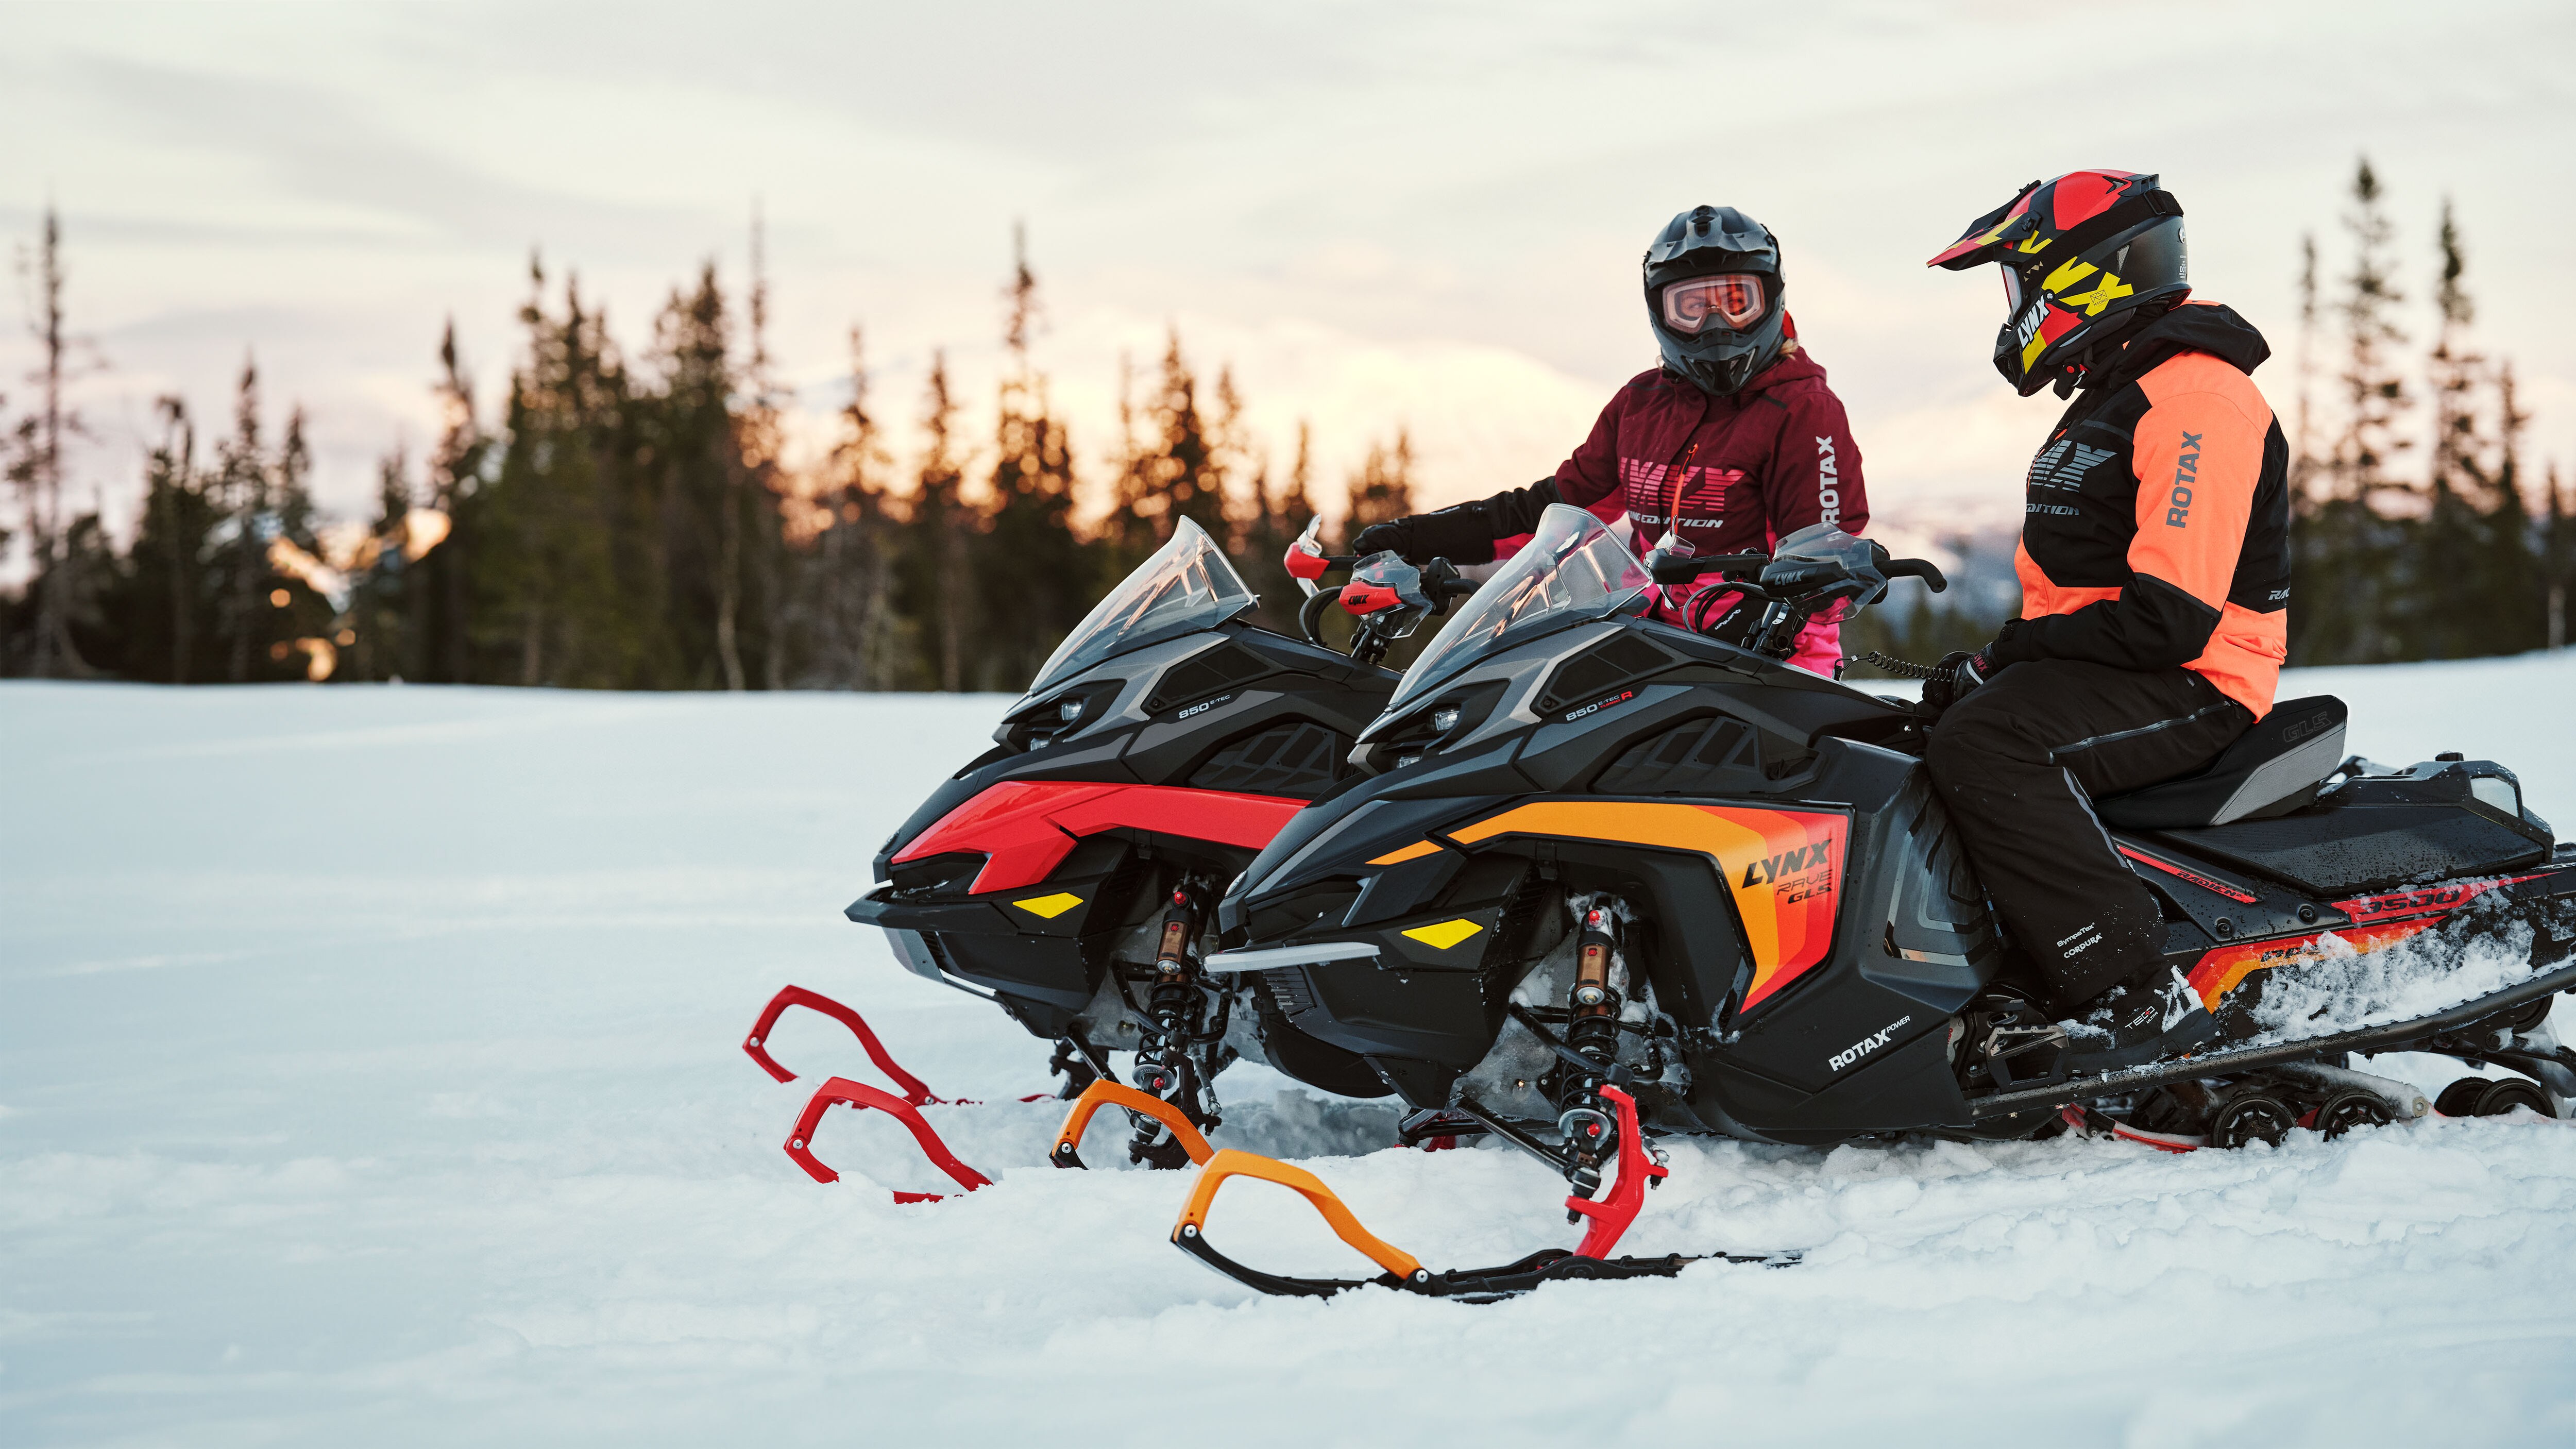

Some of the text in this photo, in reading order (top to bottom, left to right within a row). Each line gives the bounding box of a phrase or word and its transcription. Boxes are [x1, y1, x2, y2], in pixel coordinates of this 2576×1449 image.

[2017, 295, 2049, 348] LYNX
[1816, 435, 1840, 527] ROTAX
[2166, 431, 2202, 528] ROTAX
[1774, 570, 1805, 585] LYNX
[1348, 594, 1369, 606] LYNX
[1179, 695, 1230, 719] 850 E-TEC
[1566, 690, 1633, 721] 850 E-TEC R
[1600, 699, 1621, 708] TURBO
[2283, 711, 2332, 743] GLS
[1741, 838, 1833, 889] LYNX
[1776, 869, 1833, 896] RAVE
[1787, 883, 1832, 904] GLS
[2146, 1011, 2158, 1024] ULTRA
[1828, 1015, 1910, 1071] ROTAX POWER
